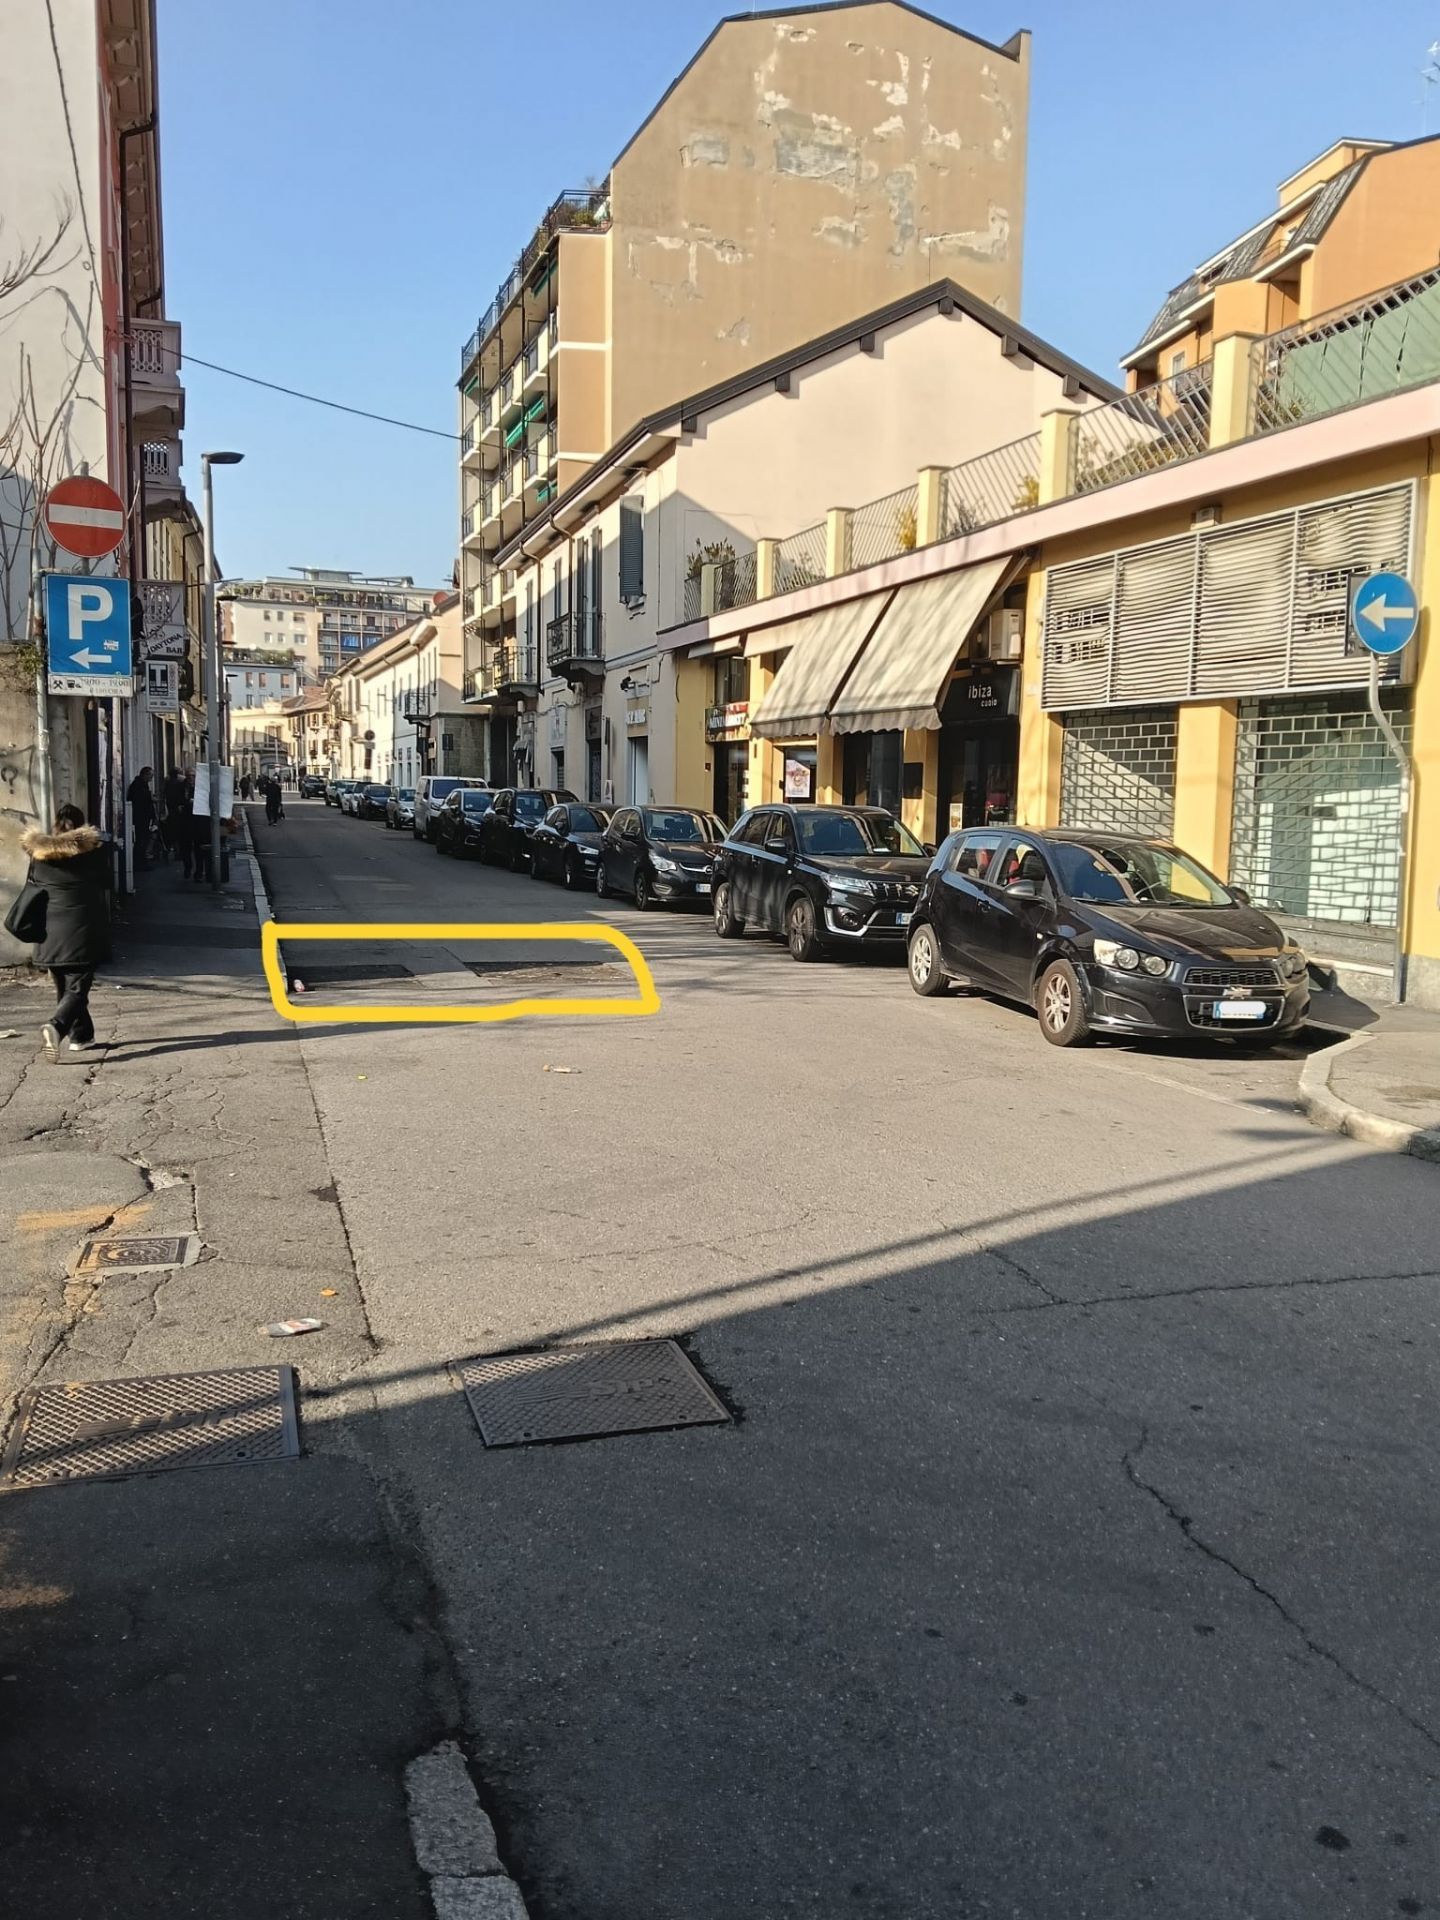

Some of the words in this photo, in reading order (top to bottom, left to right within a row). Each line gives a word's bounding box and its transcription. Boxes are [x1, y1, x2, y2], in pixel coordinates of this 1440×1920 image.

[68, 584, 113, 639] P
[150, 633, 183, 655] DAYTONA
[166, 646, 183, 655] BAR
[968, 684, 992, 699] ibiza
